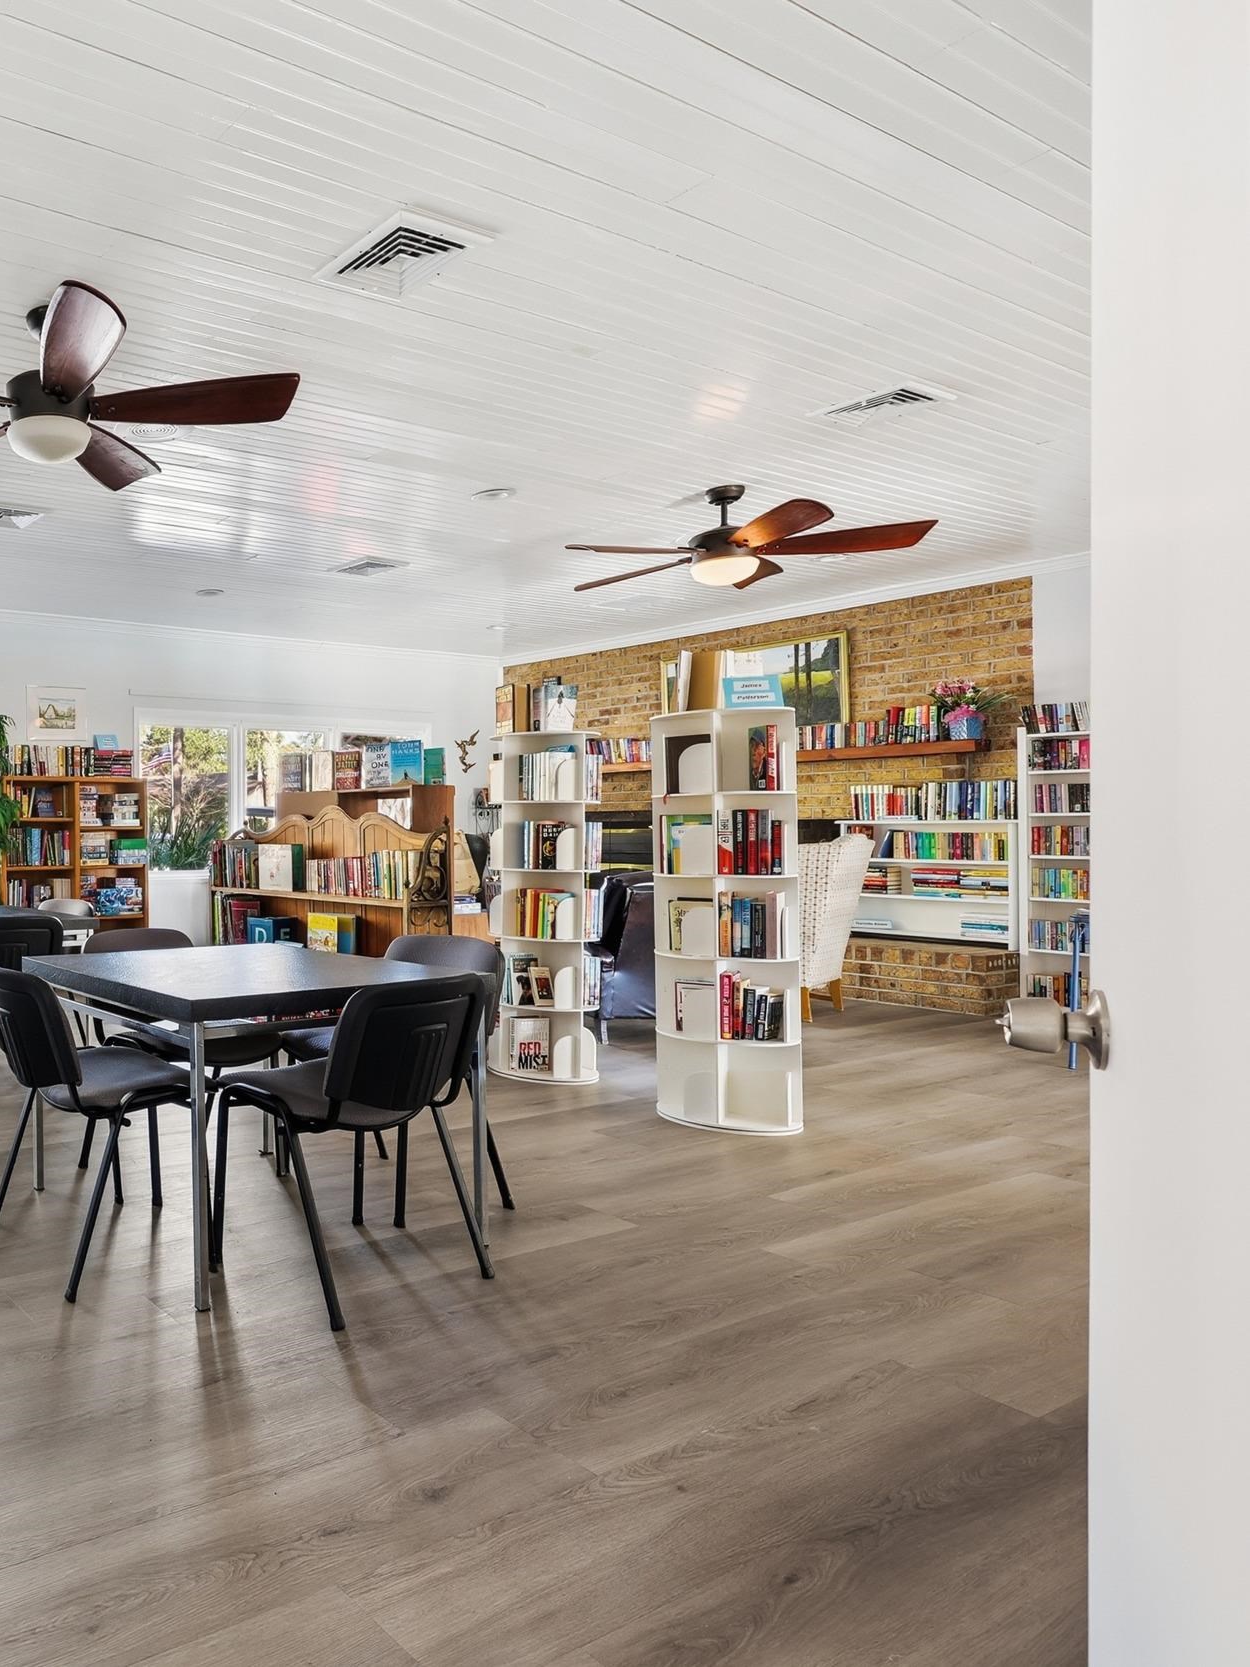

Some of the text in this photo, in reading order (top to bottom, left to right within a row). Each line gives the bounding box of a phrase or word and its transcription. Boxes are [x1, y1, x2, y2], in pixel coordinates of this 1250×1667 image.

[372, 760, 389, 768] ONE
[254, 927, 267, 944] D
[520, 1042, 541, 1055] RED
[518, 1054, 548, 1070] MIST
